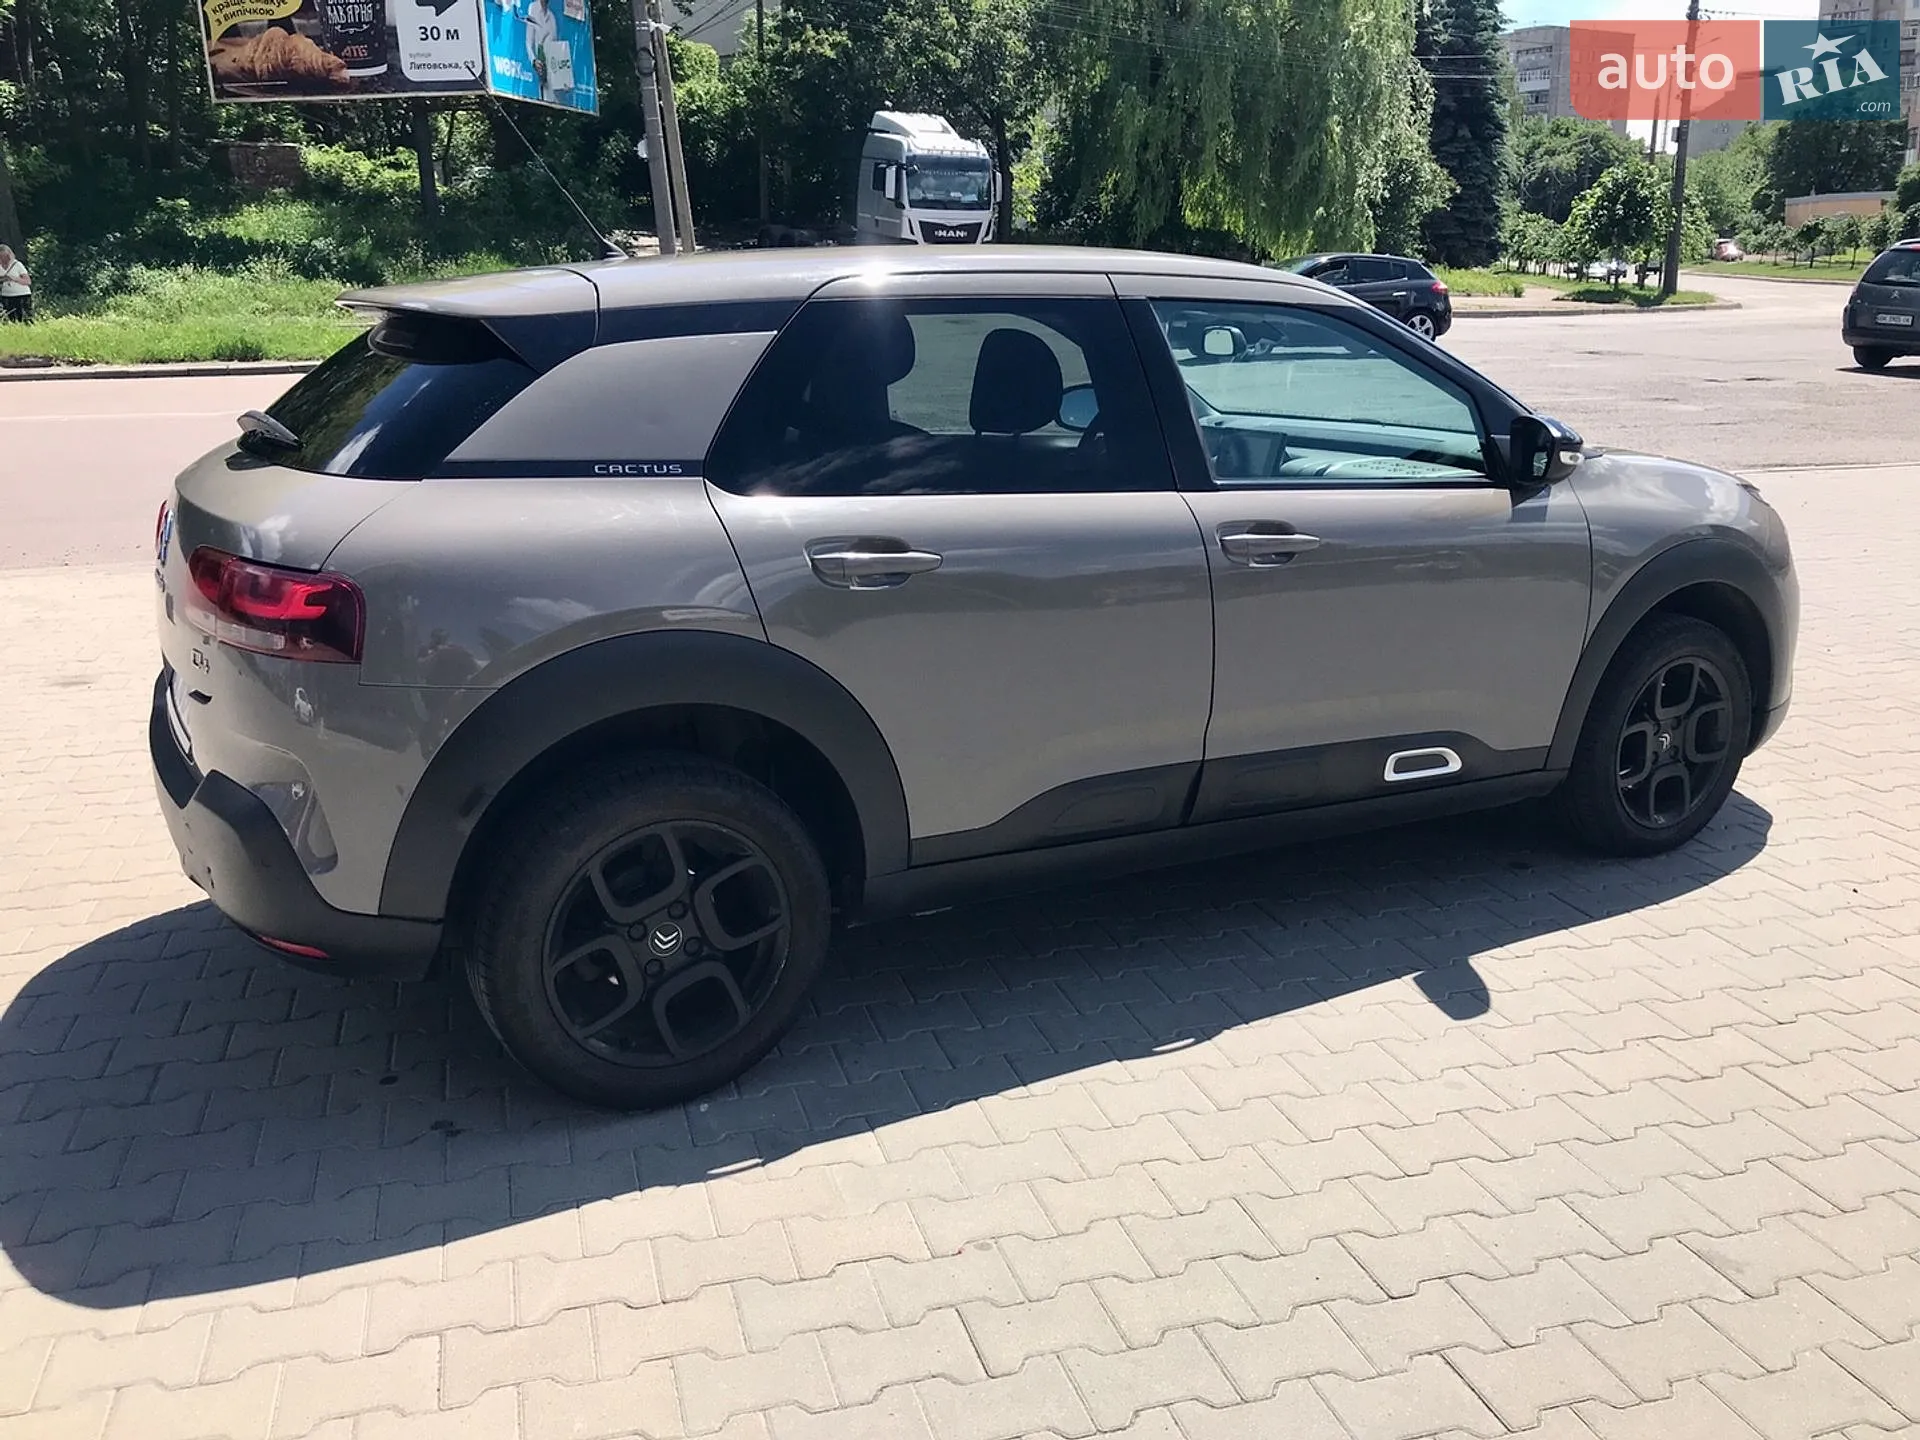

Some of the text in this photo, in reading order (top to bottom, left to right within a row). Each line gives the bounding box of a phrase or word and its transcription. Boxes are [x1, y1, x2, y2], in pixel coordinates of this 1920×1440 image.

[222, 6, 275, 21] випічкою
[418, 25, 460, 42] 30 м
[936, 230, 966, 239] MAN
[594, 463, 682, 474] CACTUS
